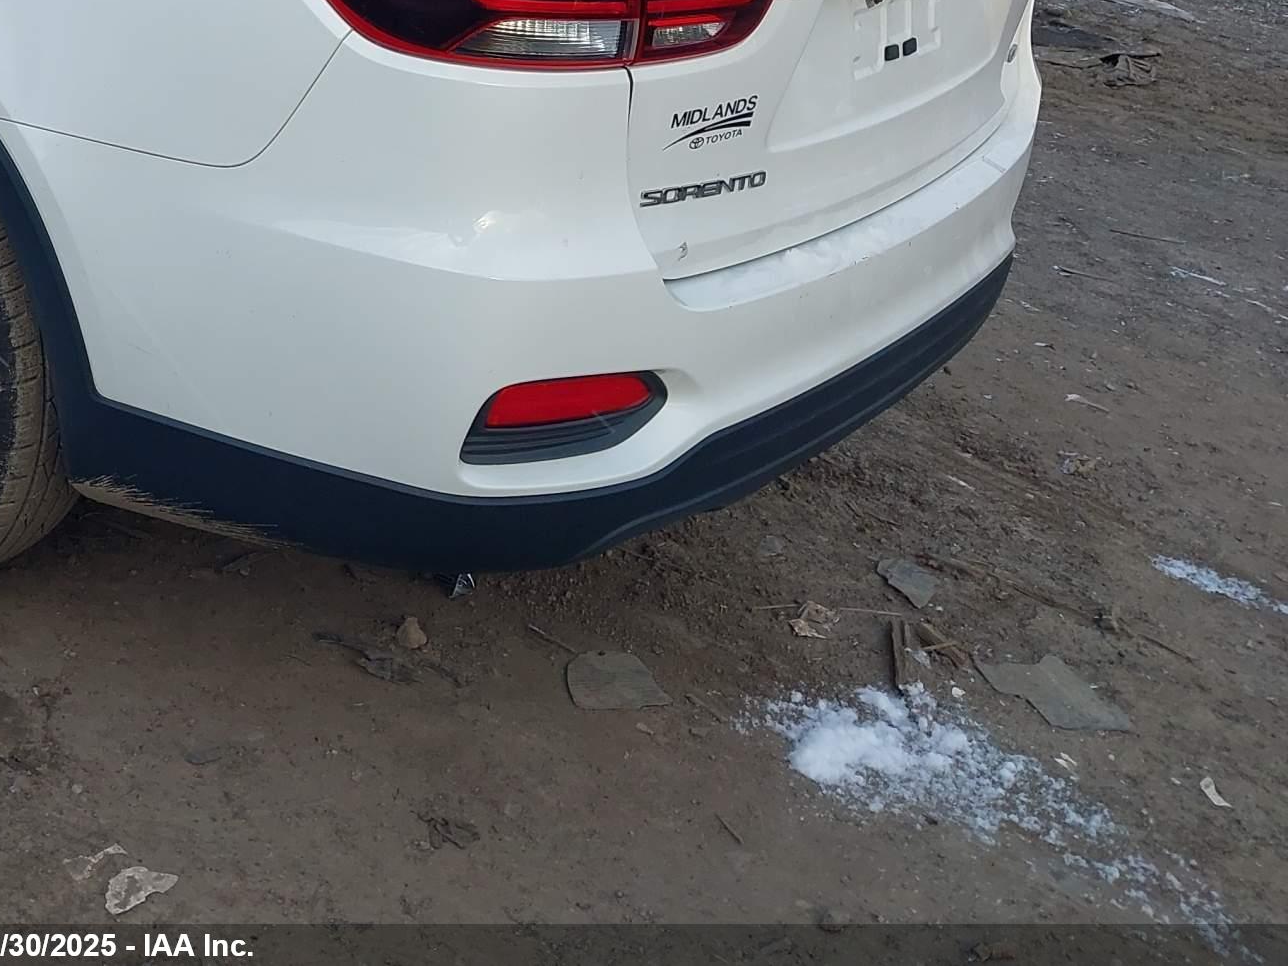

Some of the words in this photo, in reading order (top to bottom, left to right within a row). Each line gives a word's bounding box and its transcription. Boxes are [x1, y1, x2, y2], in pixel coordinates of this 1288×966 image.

[671, 95, 758, 129] MIDLANDS
[705, 129, 743, 145] TOYOTA
[640, 171, 767, 208] SORENTO
